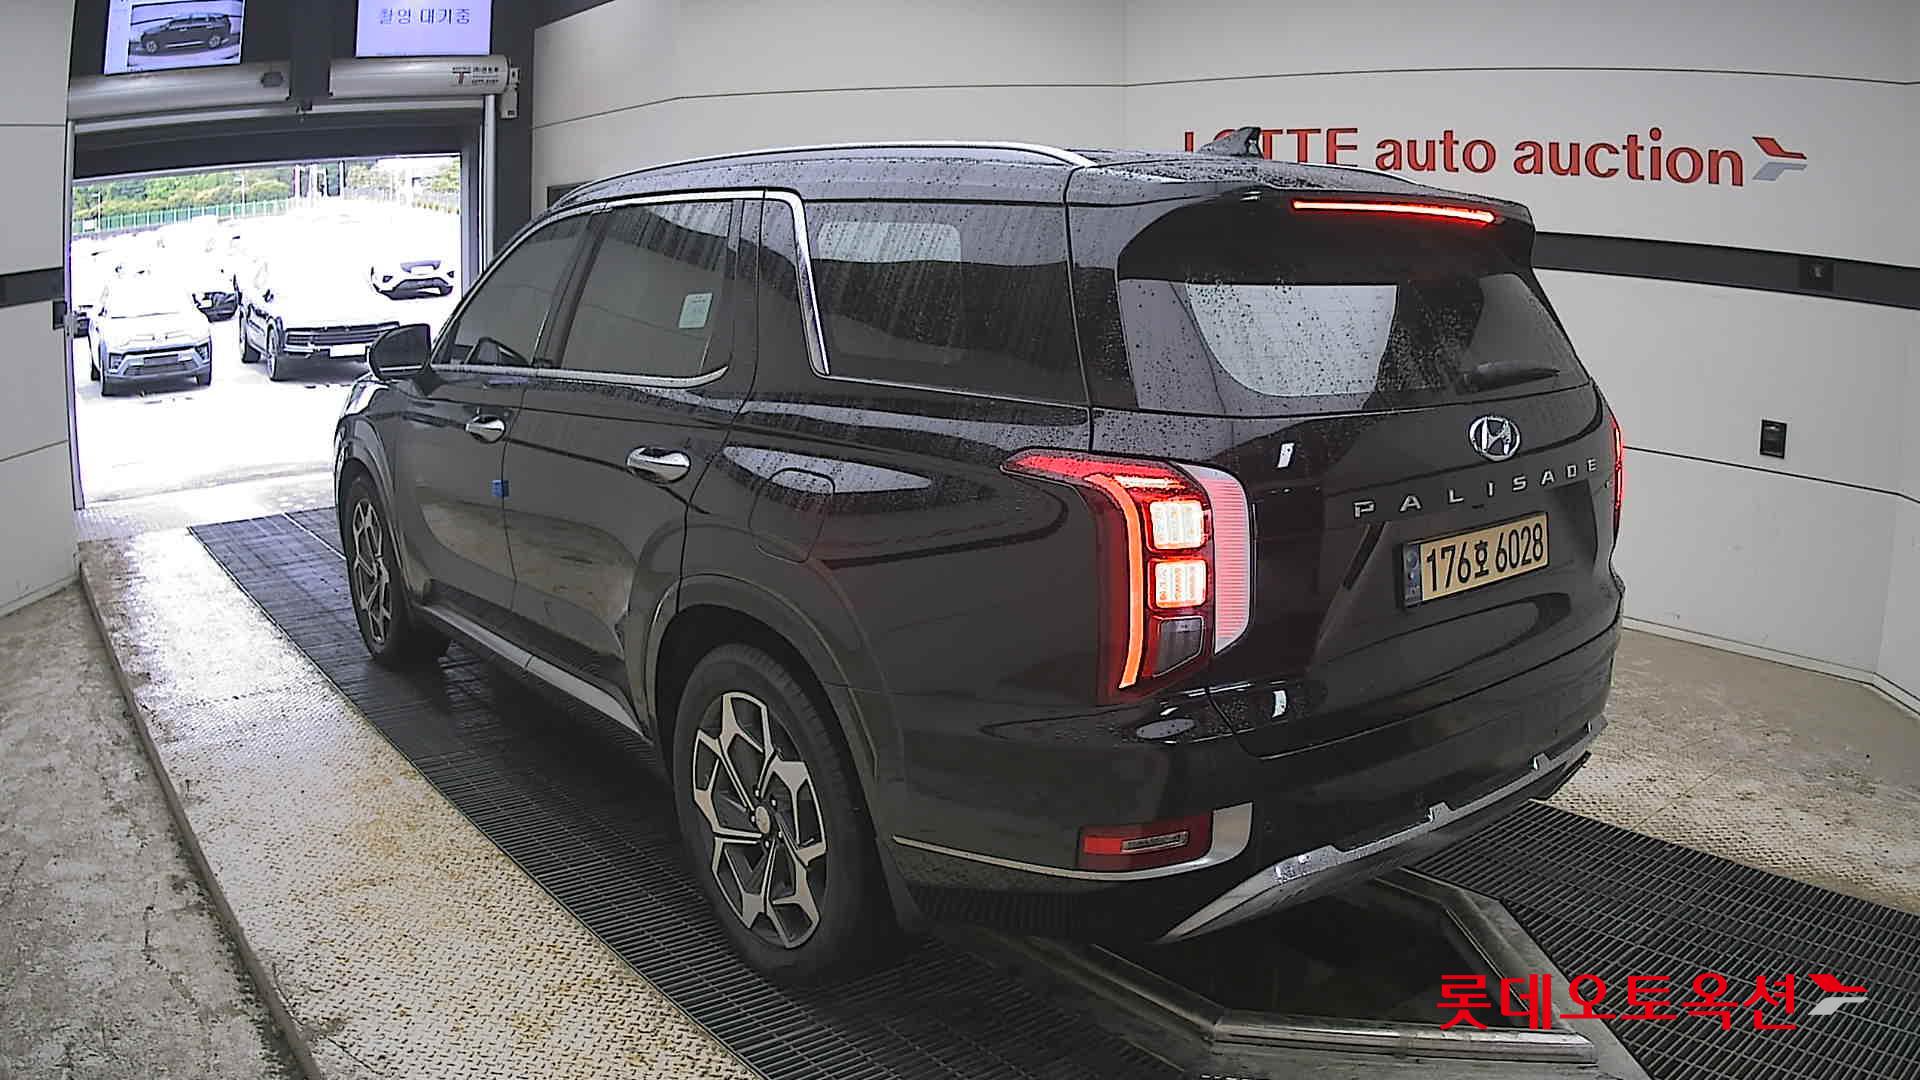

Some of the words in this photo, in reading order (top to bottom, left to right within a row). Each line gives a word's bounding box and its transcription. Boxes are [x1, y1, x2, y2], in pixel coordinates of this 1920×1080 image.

[420, 8, 470, 24] 대기중
[1375, 129, 1497, 174] auto
[1512, 127, 1745, 187] auction
[1353, 458, 1598, 518] PALISADE
[1426, 539, 1490, 592] 176호
[1495, 523, 1544, 573] 6028
